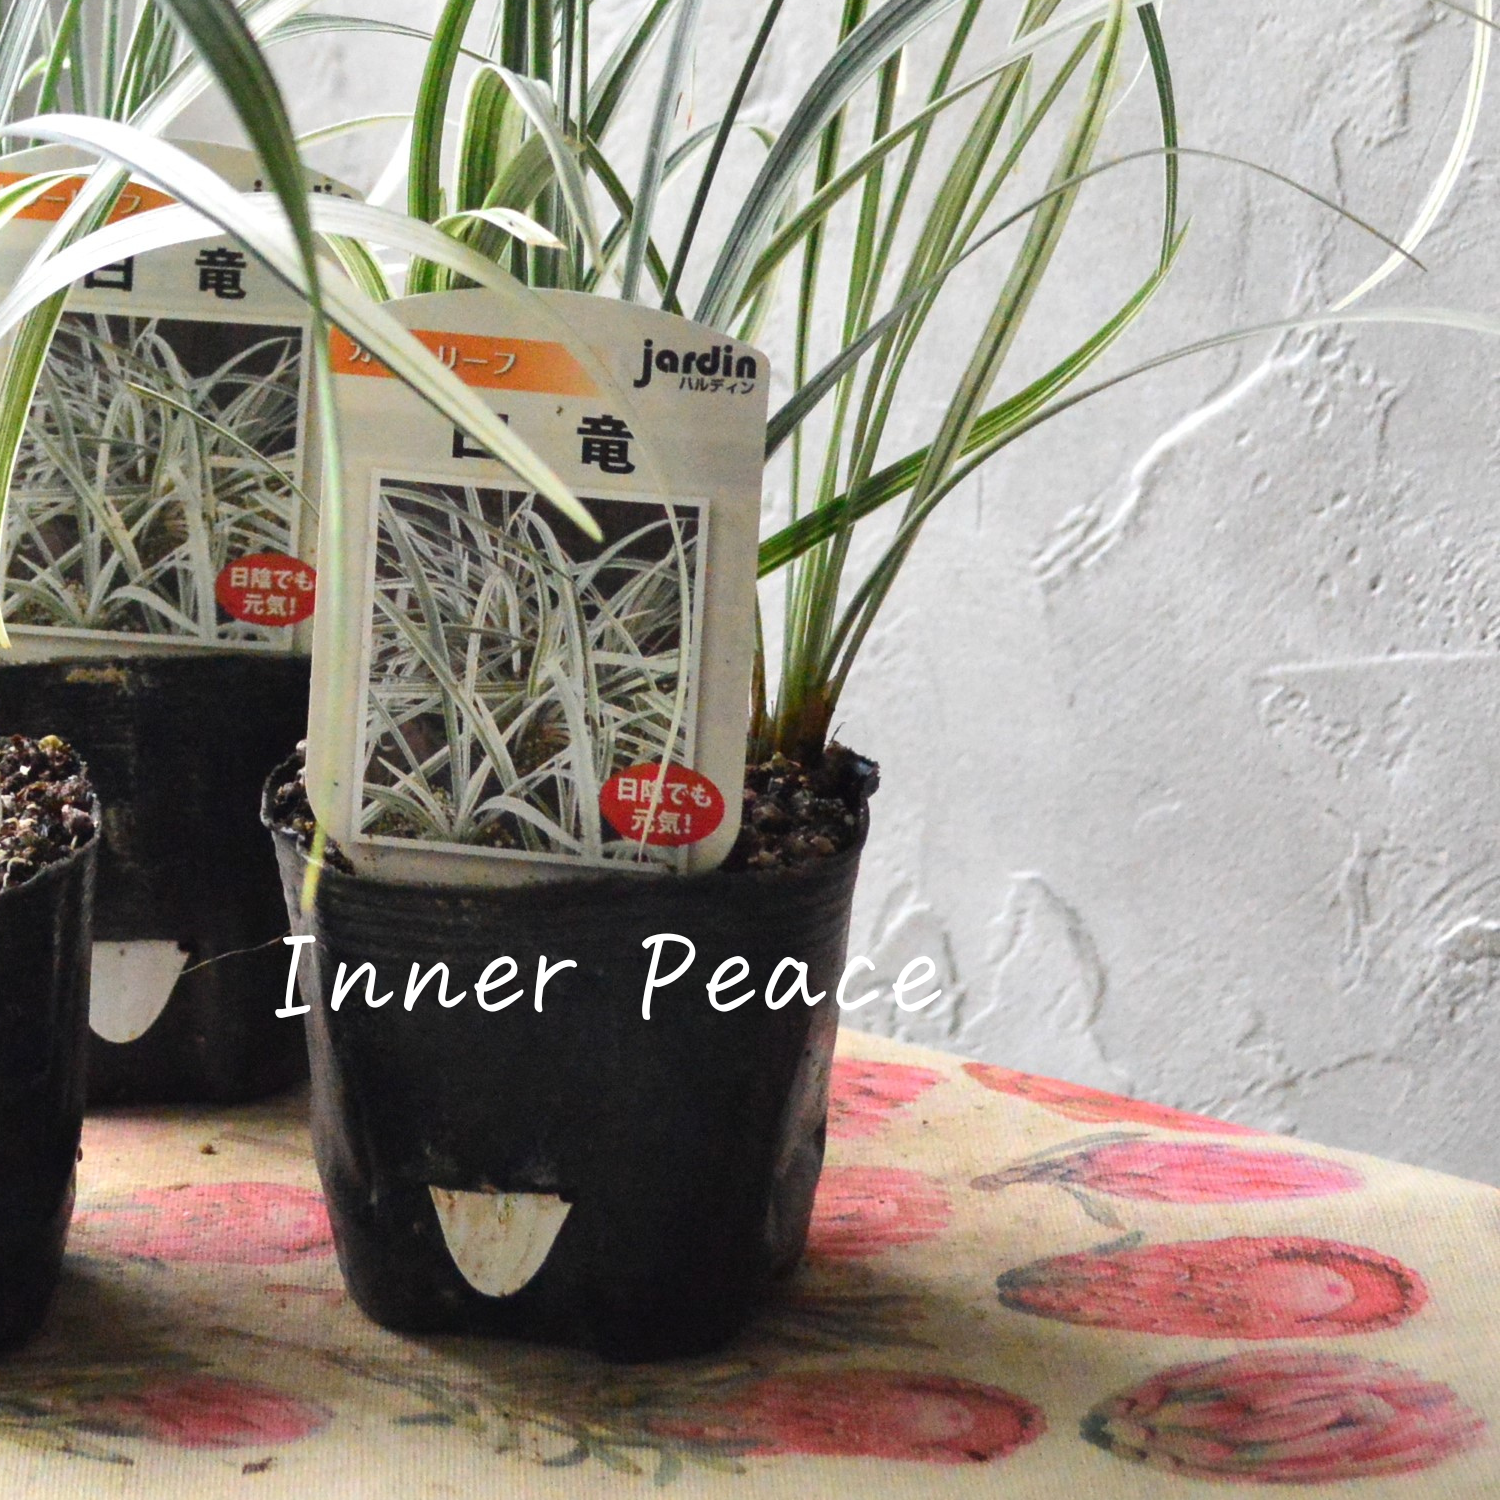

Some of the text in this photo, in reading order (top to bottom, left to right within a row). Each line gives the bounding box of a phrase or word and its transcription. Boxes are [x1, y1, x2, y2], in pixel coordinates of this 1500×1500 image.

[633, 338, 757, 389] jardin
[679, 377, 755, 395] ハルディン
[230, 566, 314, 591] 日陰でも
[617, 777, 712, 807] 日陰でも
